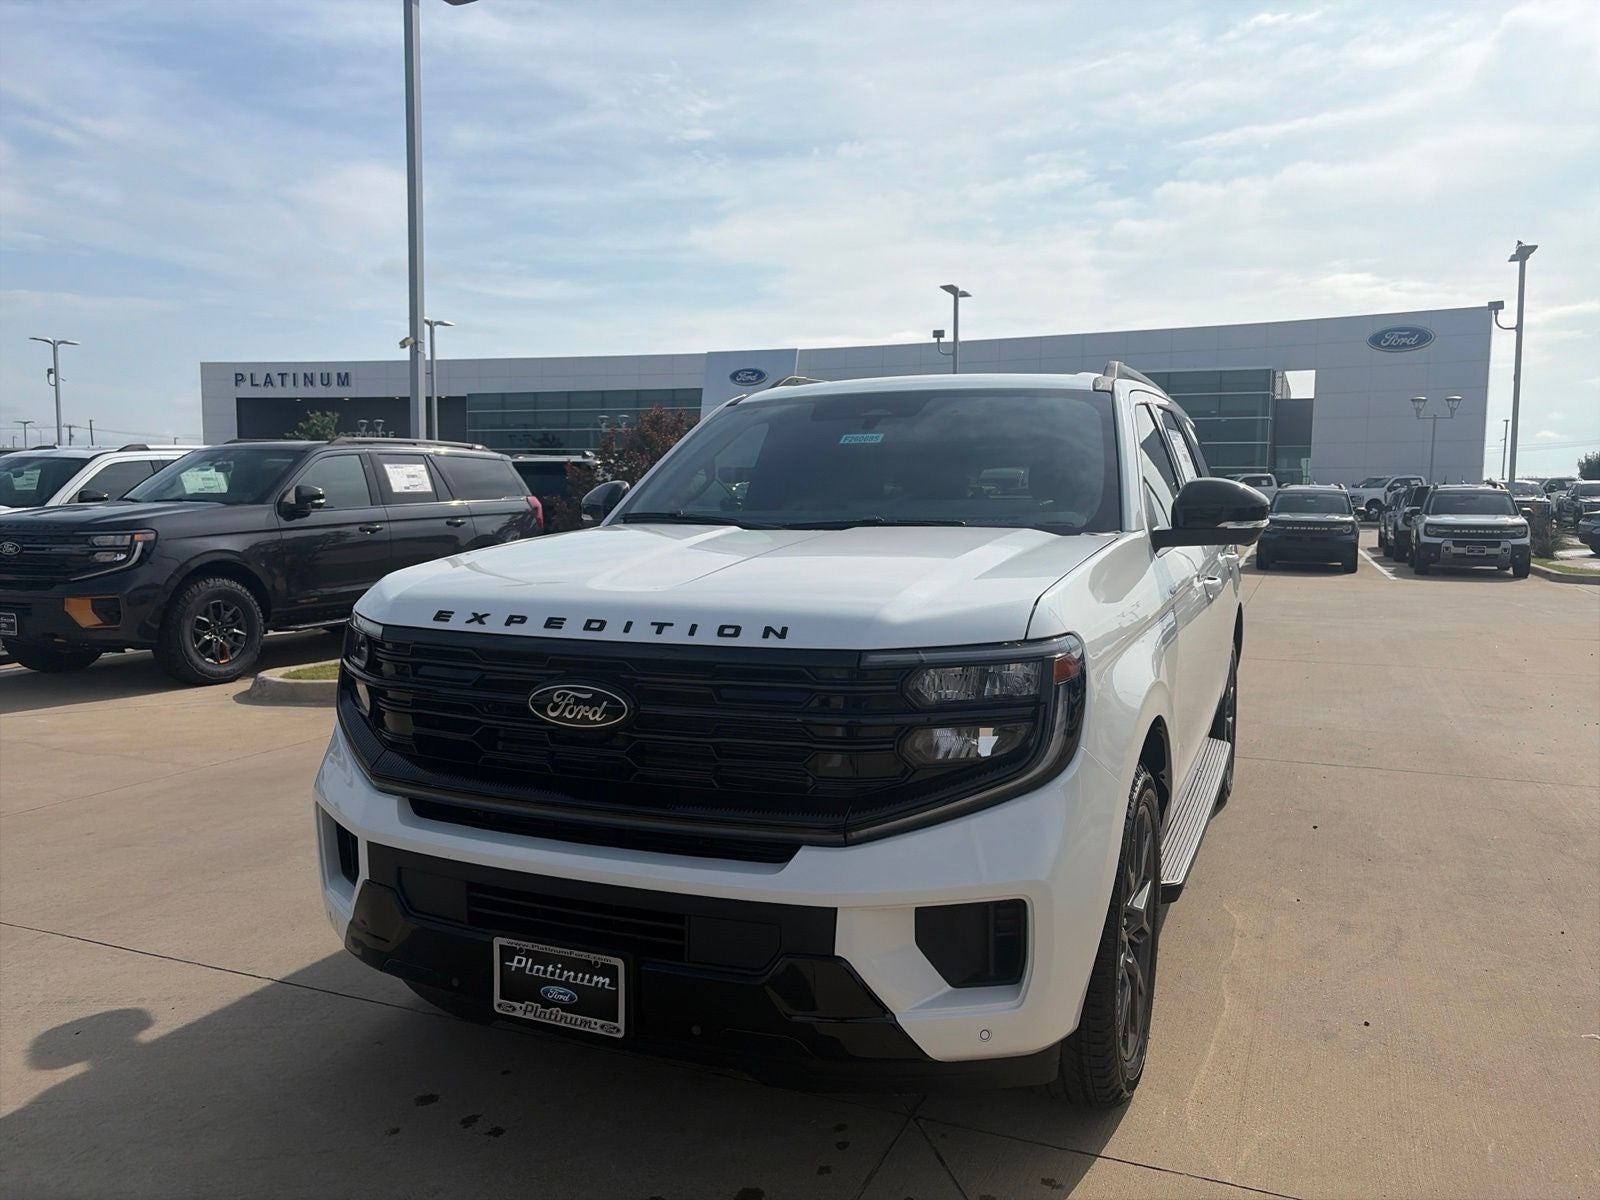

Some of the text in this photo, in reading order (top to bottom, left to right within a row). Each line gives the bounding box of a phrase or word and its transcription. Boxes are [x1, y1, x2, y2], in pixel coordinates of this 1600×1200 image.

[1381, 331, 1419, 347] Ford
[234, 372, 351, 388] PLATINUM
[432, 610, 789, 639] EXPEDITION
[547, 690, 609, 723] Ford
[504, 955, 617, 991] Platinum
[522, 1002, 598, 1031] Platinum
